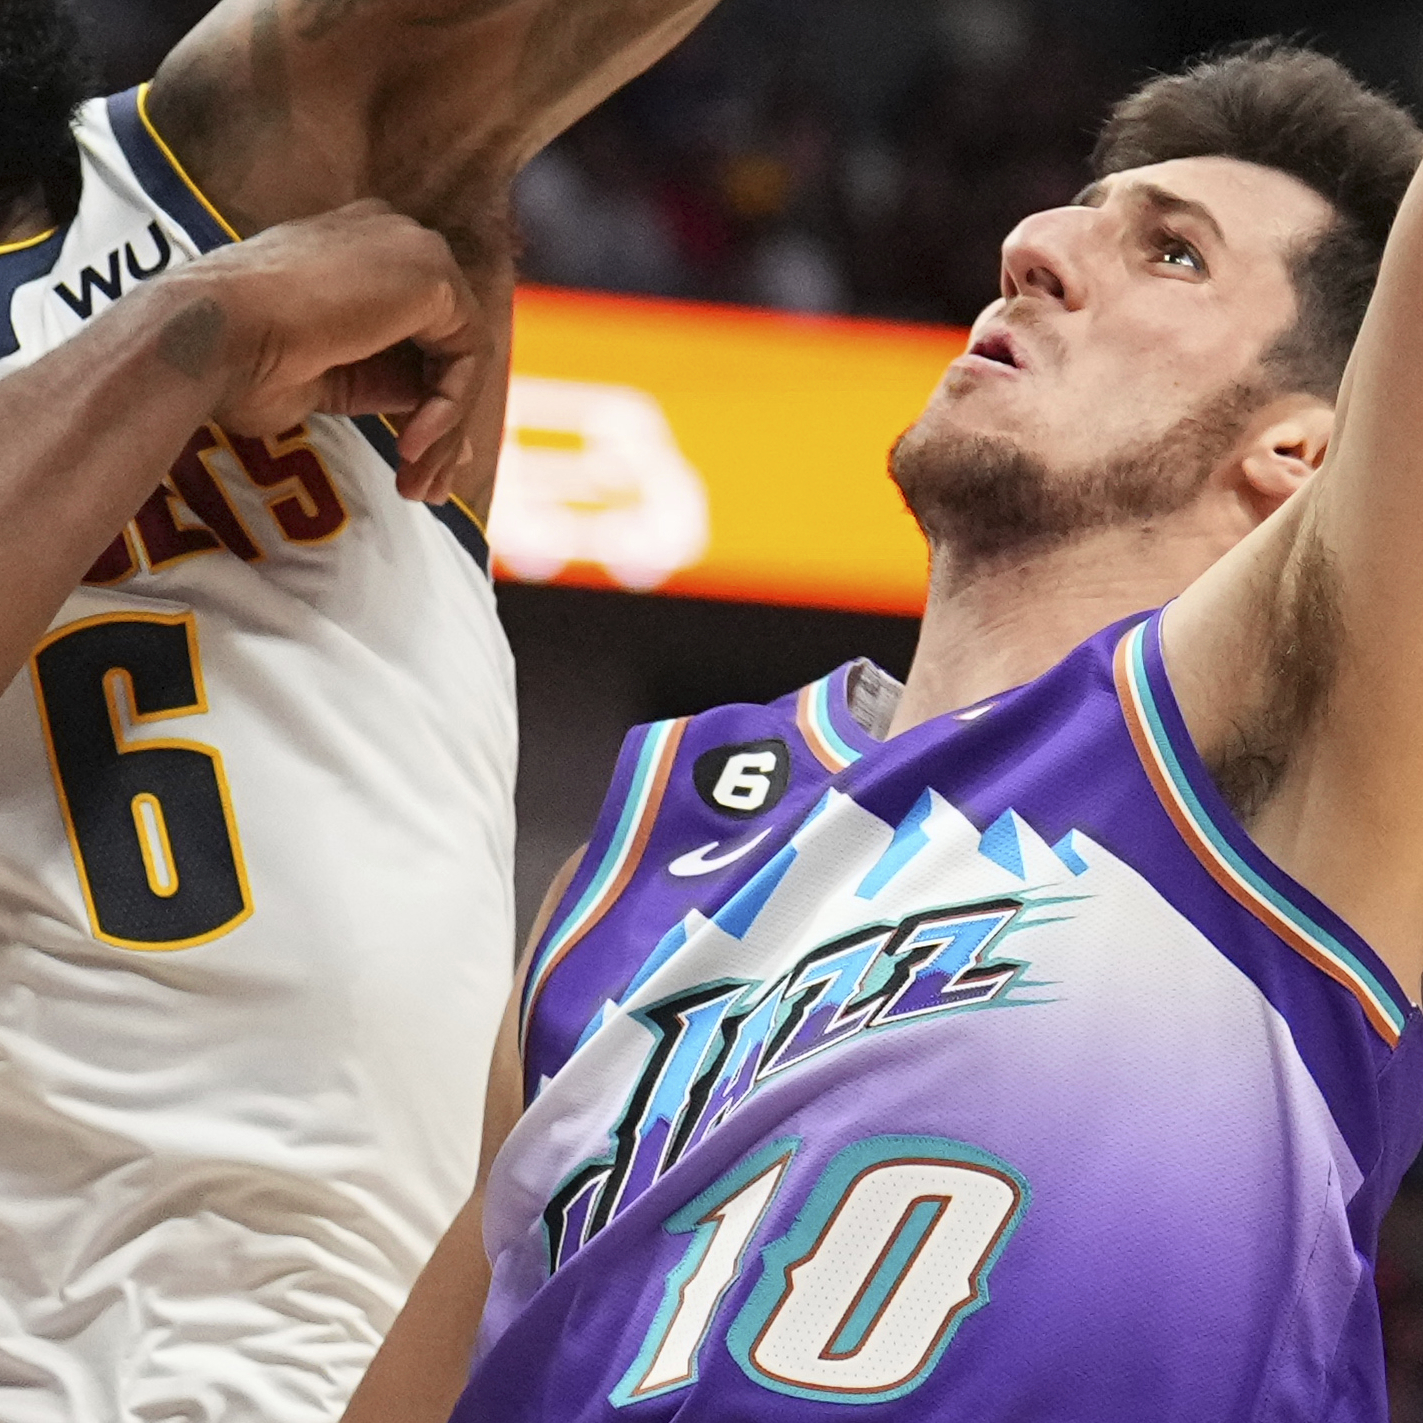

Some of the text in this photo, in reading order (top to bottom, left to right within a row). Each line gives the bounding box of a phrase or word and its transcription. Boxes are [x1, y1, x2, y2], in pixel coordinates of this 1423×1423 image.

[53, 219, 171, 320] WU
[29, 610, 255, 952] 6
[712, 750, 777, 811] 6
[608, 1132, 1033, 1408] 10
